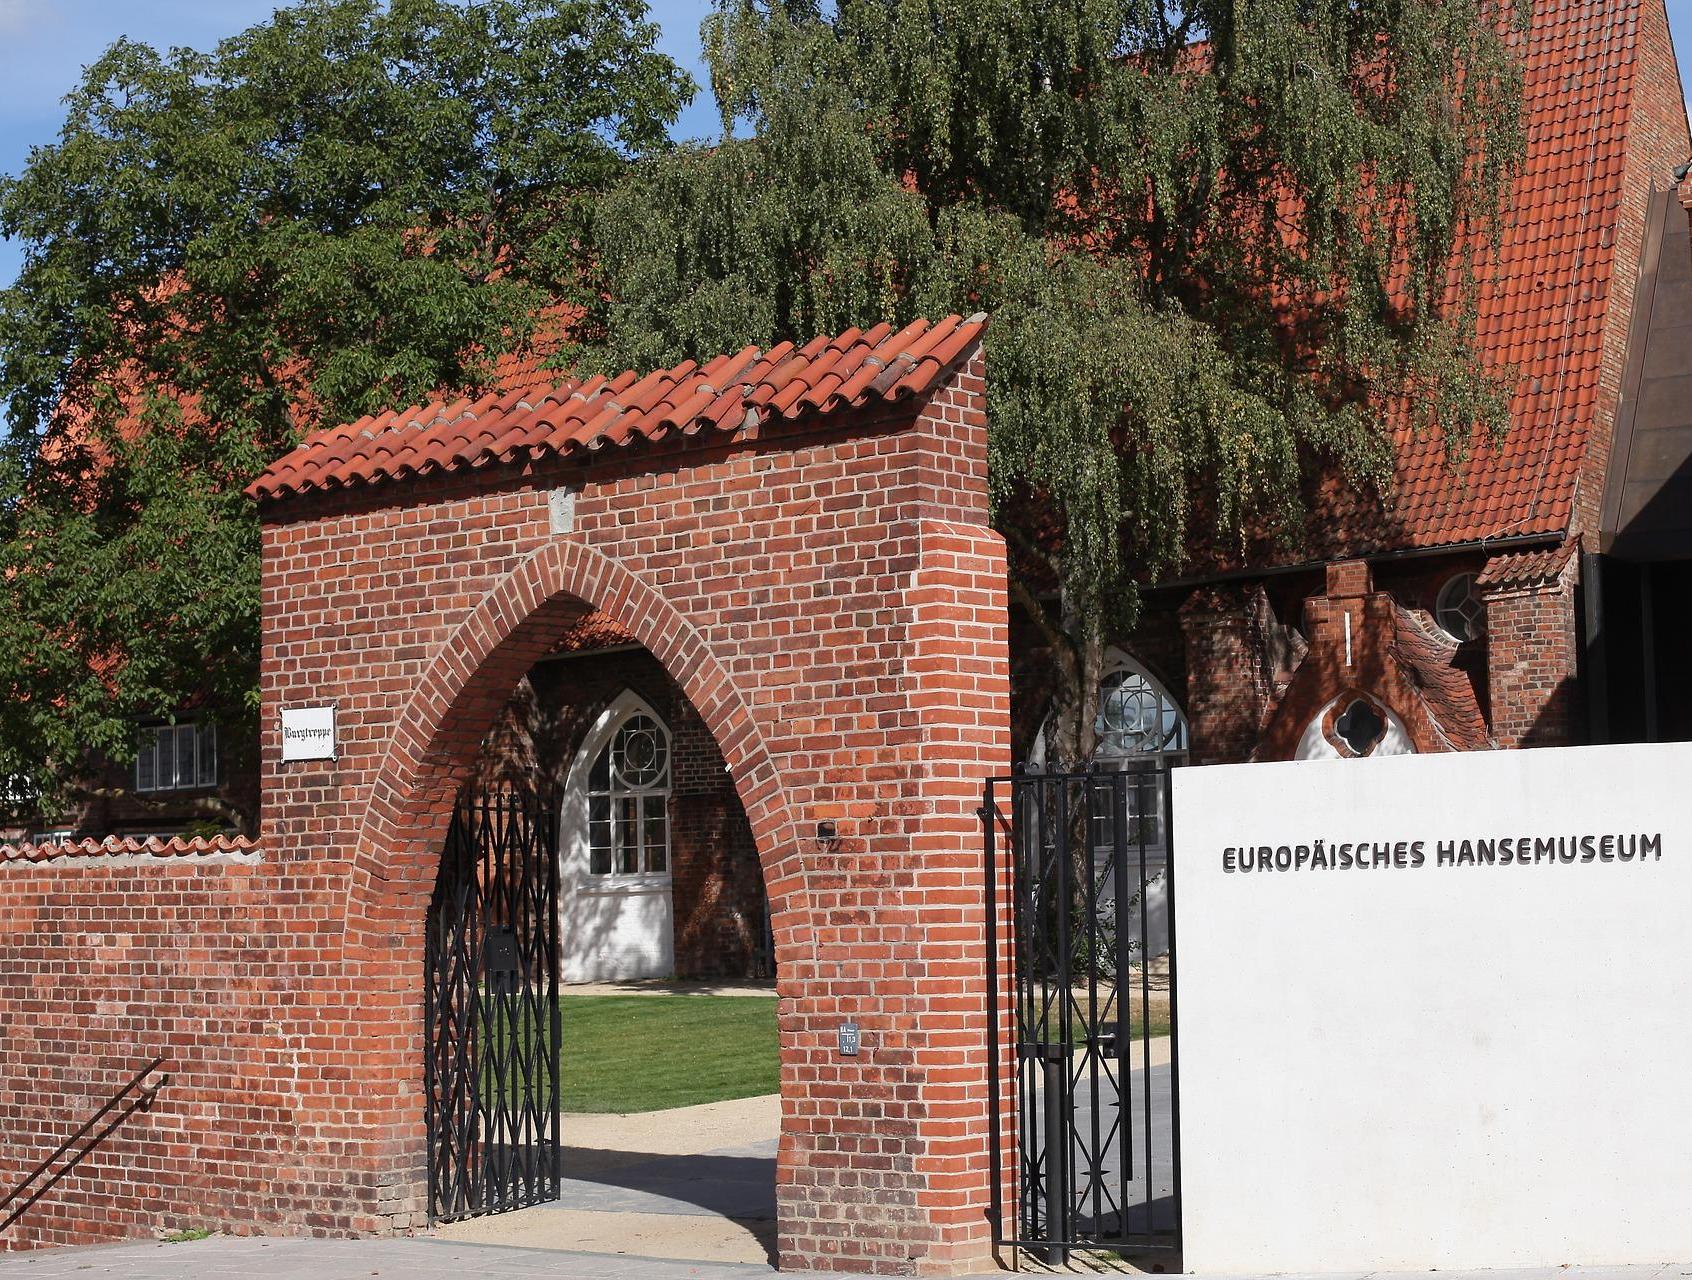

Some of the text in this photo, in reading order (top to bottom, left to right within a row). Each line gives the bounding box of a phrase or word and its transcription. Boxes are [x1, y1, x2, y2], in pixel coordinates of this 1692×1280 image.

[284, 726, 332, 742] Burgtreppe
[1222, 833, 1662, 873] EUROPÄISCHES HANSEMUSEUM
